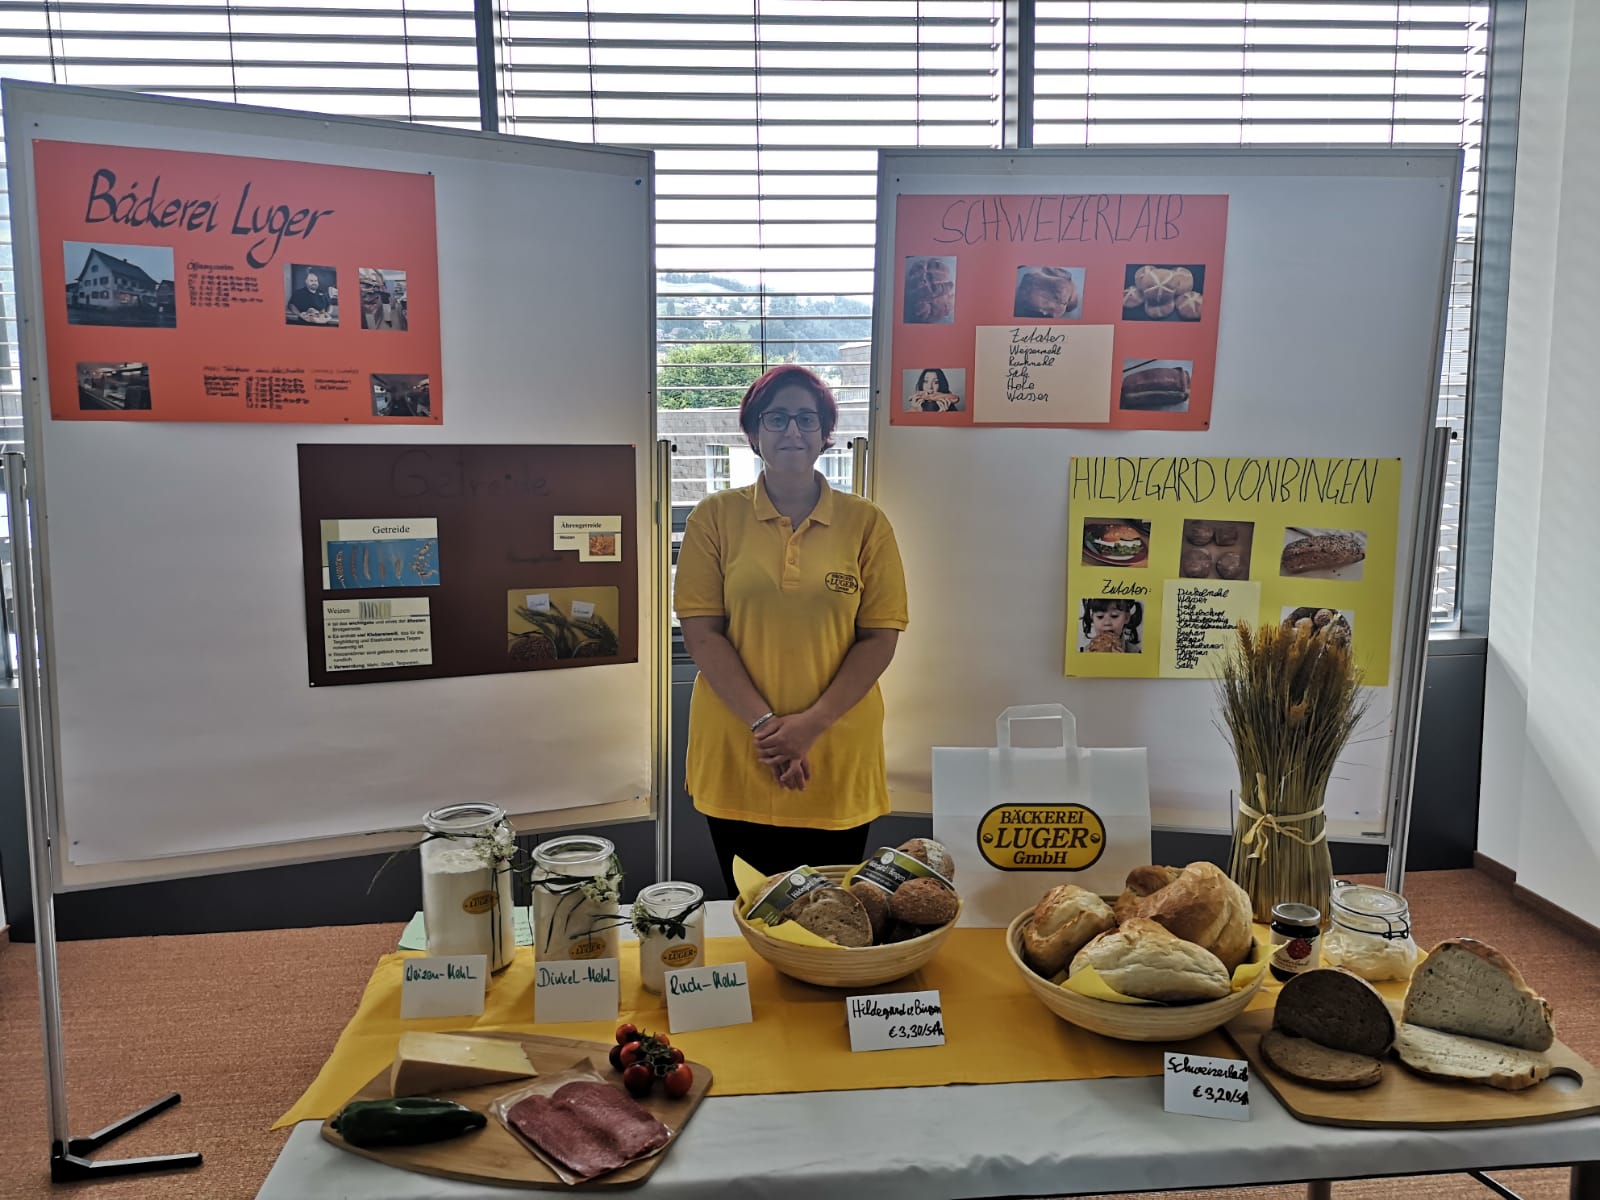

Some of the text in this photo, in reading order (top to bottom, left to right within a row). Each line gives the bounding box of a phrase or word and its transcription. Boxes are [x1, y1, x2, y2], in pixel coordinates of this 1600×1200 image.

[231, 181, 335, 269] Luger
[933, 193, 1184, 245] SCHWEIZERLAIB
[1007, 391, 1049, 403] Wasser
[1073, 457, 1216, 504] HILDEGARD
[372, 525, 411, 535] Getreide
[327, 607, 351, 615] Weizen
[1000, 809, 1085, 825] BÄCKEREI
[994, 827, 1090, 849] LUGER
[1013, 850, 1069, 865] GmbH
[852, 999, 906, 1020] Hildegard
